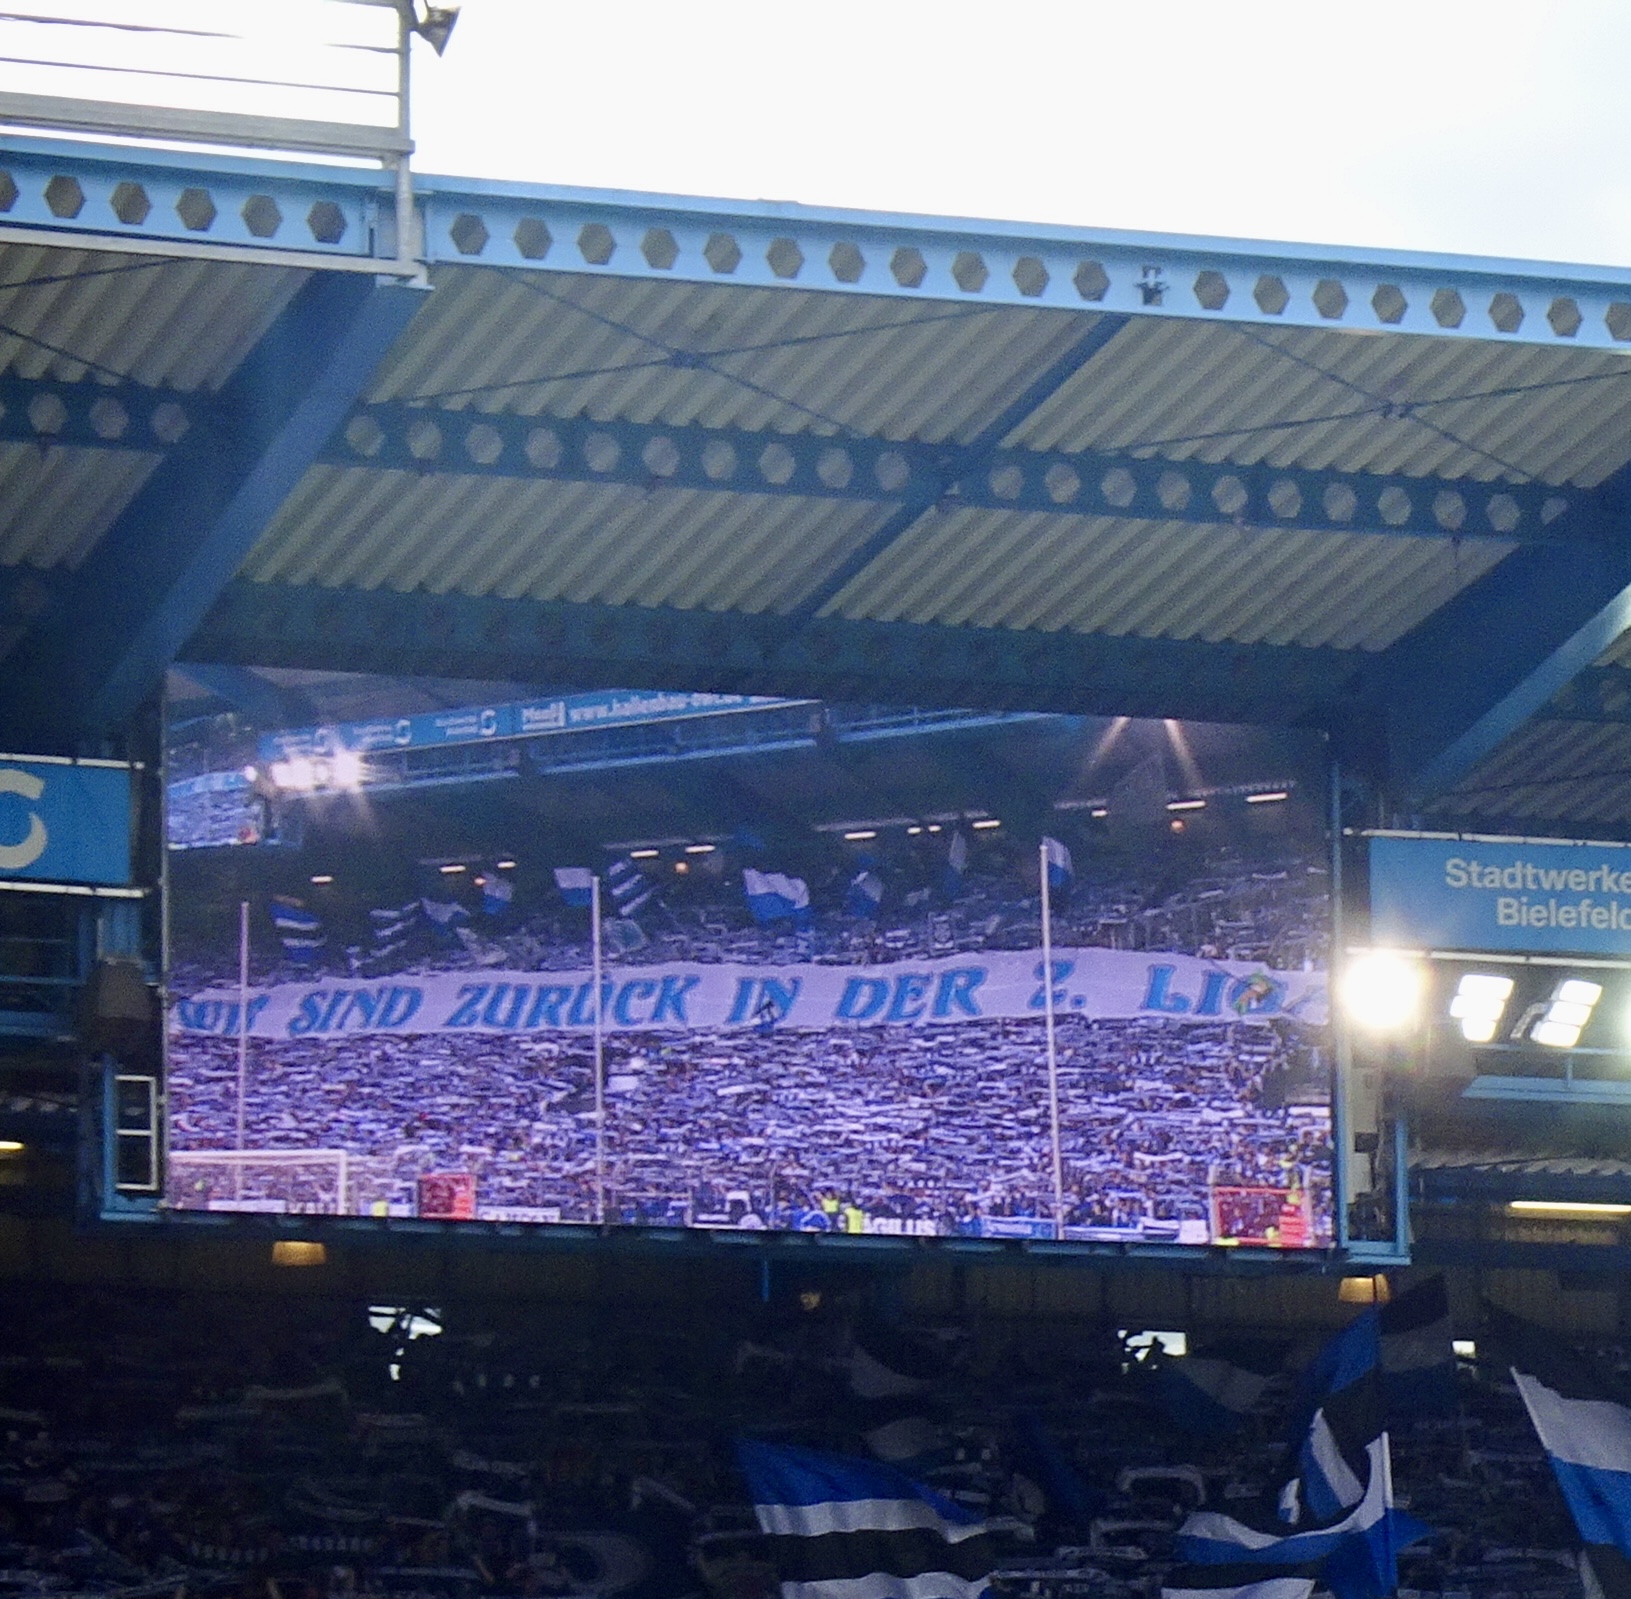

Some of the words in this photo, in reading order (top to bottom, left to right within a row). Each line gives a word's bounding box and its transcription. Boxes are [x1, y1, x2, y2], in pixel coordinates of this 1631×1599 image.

[288, 983, 424, 1037] SIND
[722, 975, 803, 1026] IN
[835, 965, 989, 1022] DER
